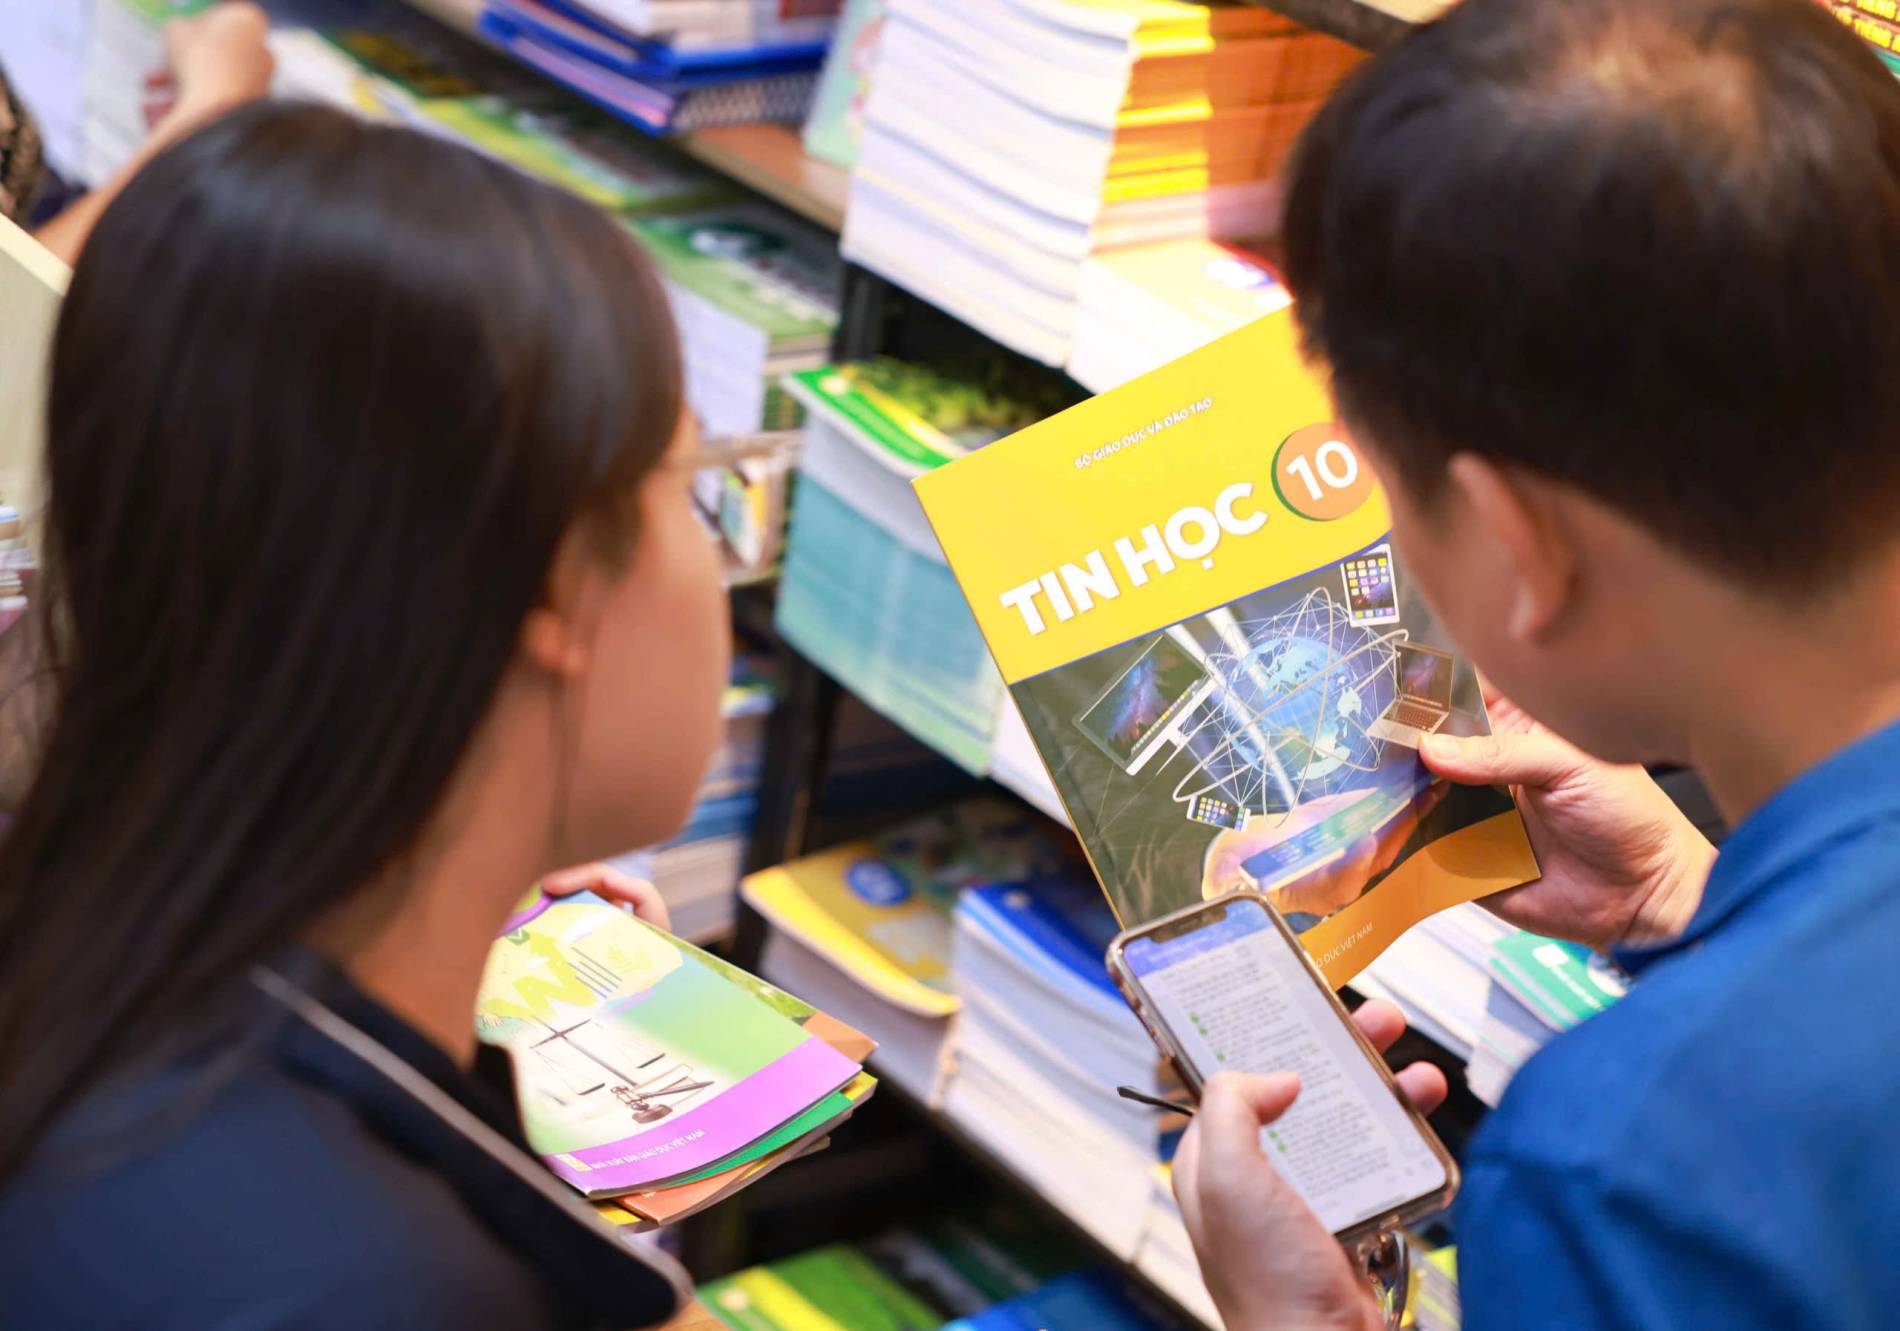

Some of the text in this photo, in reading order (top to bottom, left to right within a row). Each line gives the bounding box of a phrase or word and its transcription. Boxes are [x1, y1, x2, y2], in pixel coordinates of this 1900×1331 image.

[1286, 440, 1358, 501] 10
[1000, 482, 1268, 636] TIN HỌC
